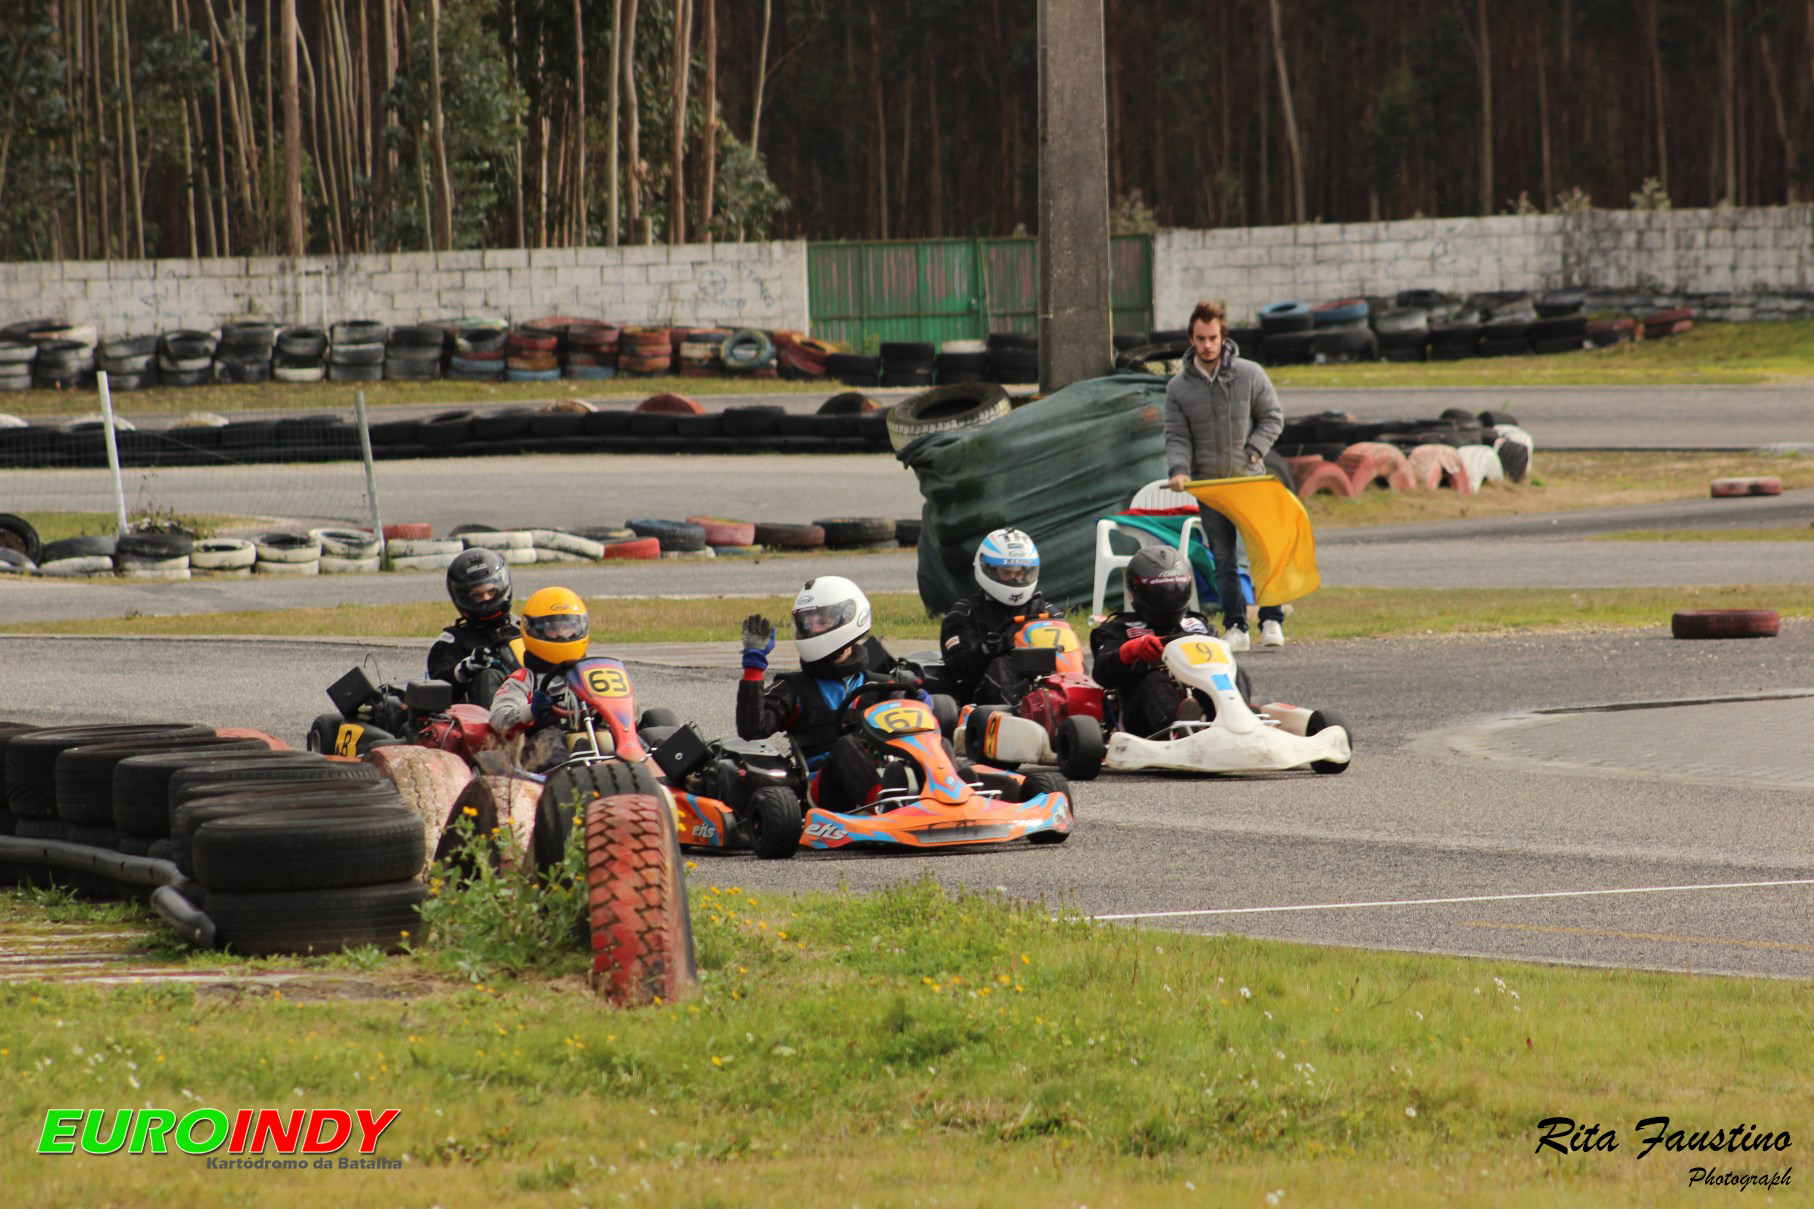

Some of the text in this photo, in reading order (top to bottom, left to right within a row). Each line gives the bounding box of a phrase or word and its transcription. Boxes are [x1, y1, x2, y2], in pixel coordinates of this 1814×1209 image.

[1043, 628, 1061, 648] 7
[1195, 642, 1213, 662] 9
[588, 670, 628, 692] 63
[883, 708, 923, 732] 67
